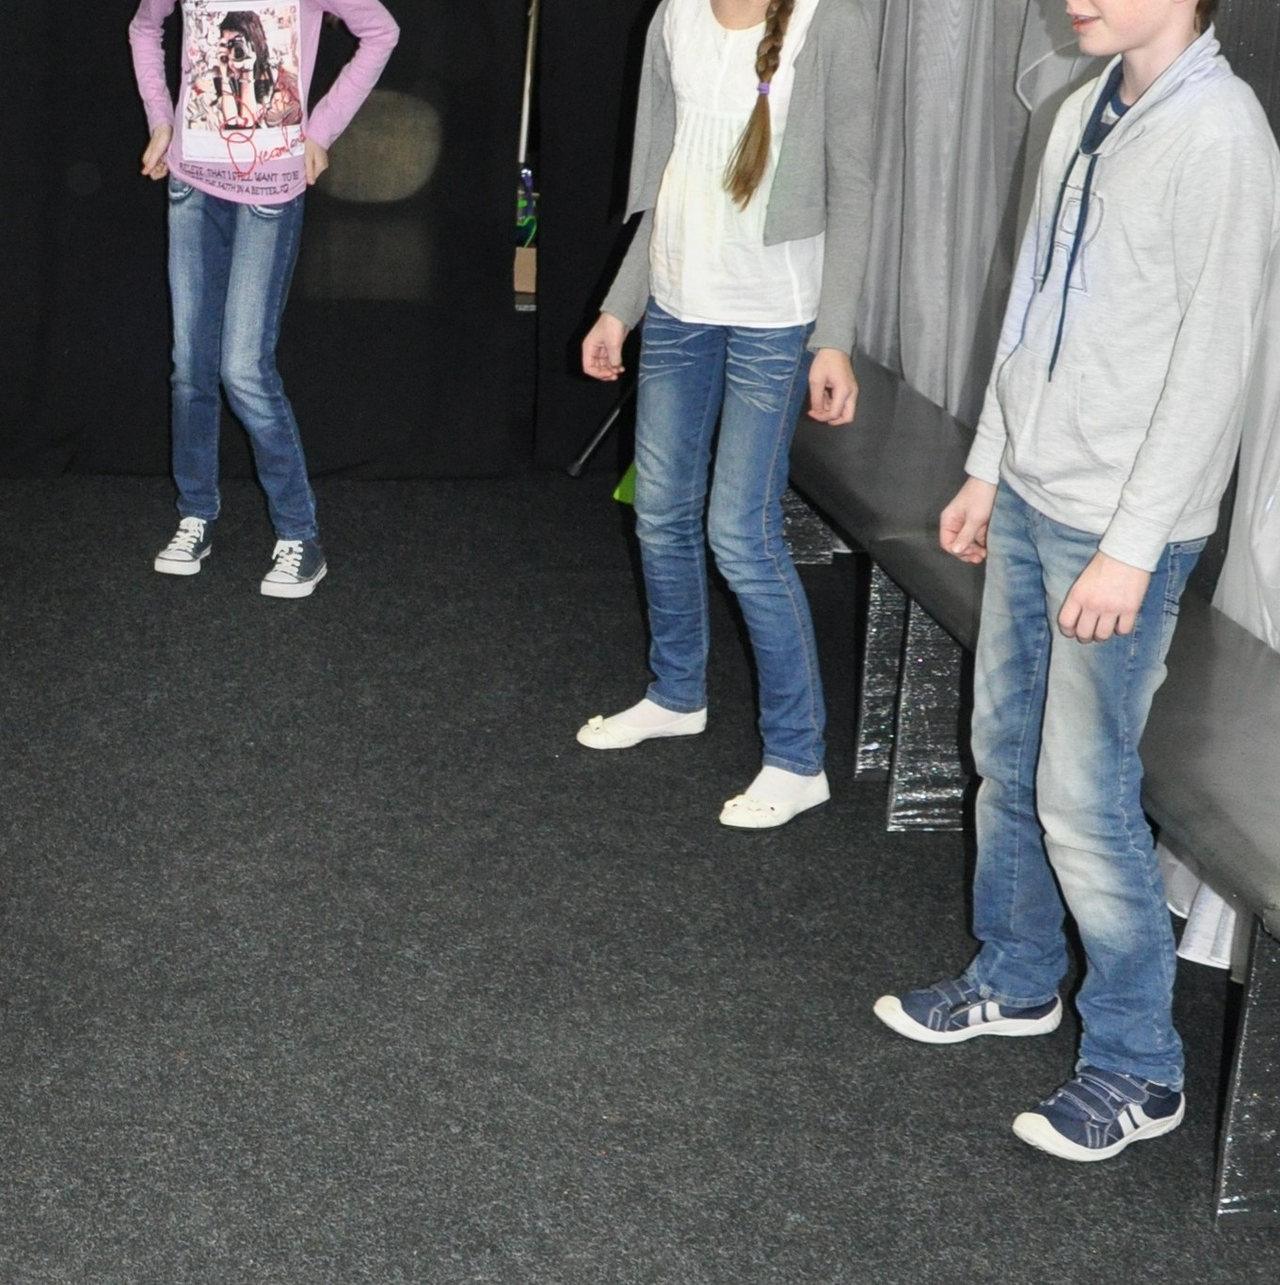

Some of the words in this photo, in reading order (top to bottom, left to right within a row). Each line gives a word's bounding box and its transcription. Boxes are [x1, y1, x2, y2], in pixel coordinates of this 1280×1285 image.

[207, 168, 226, 180] THAT
[254, 172, 279, 183] WANT
[282, 172, 292, 182] TO
